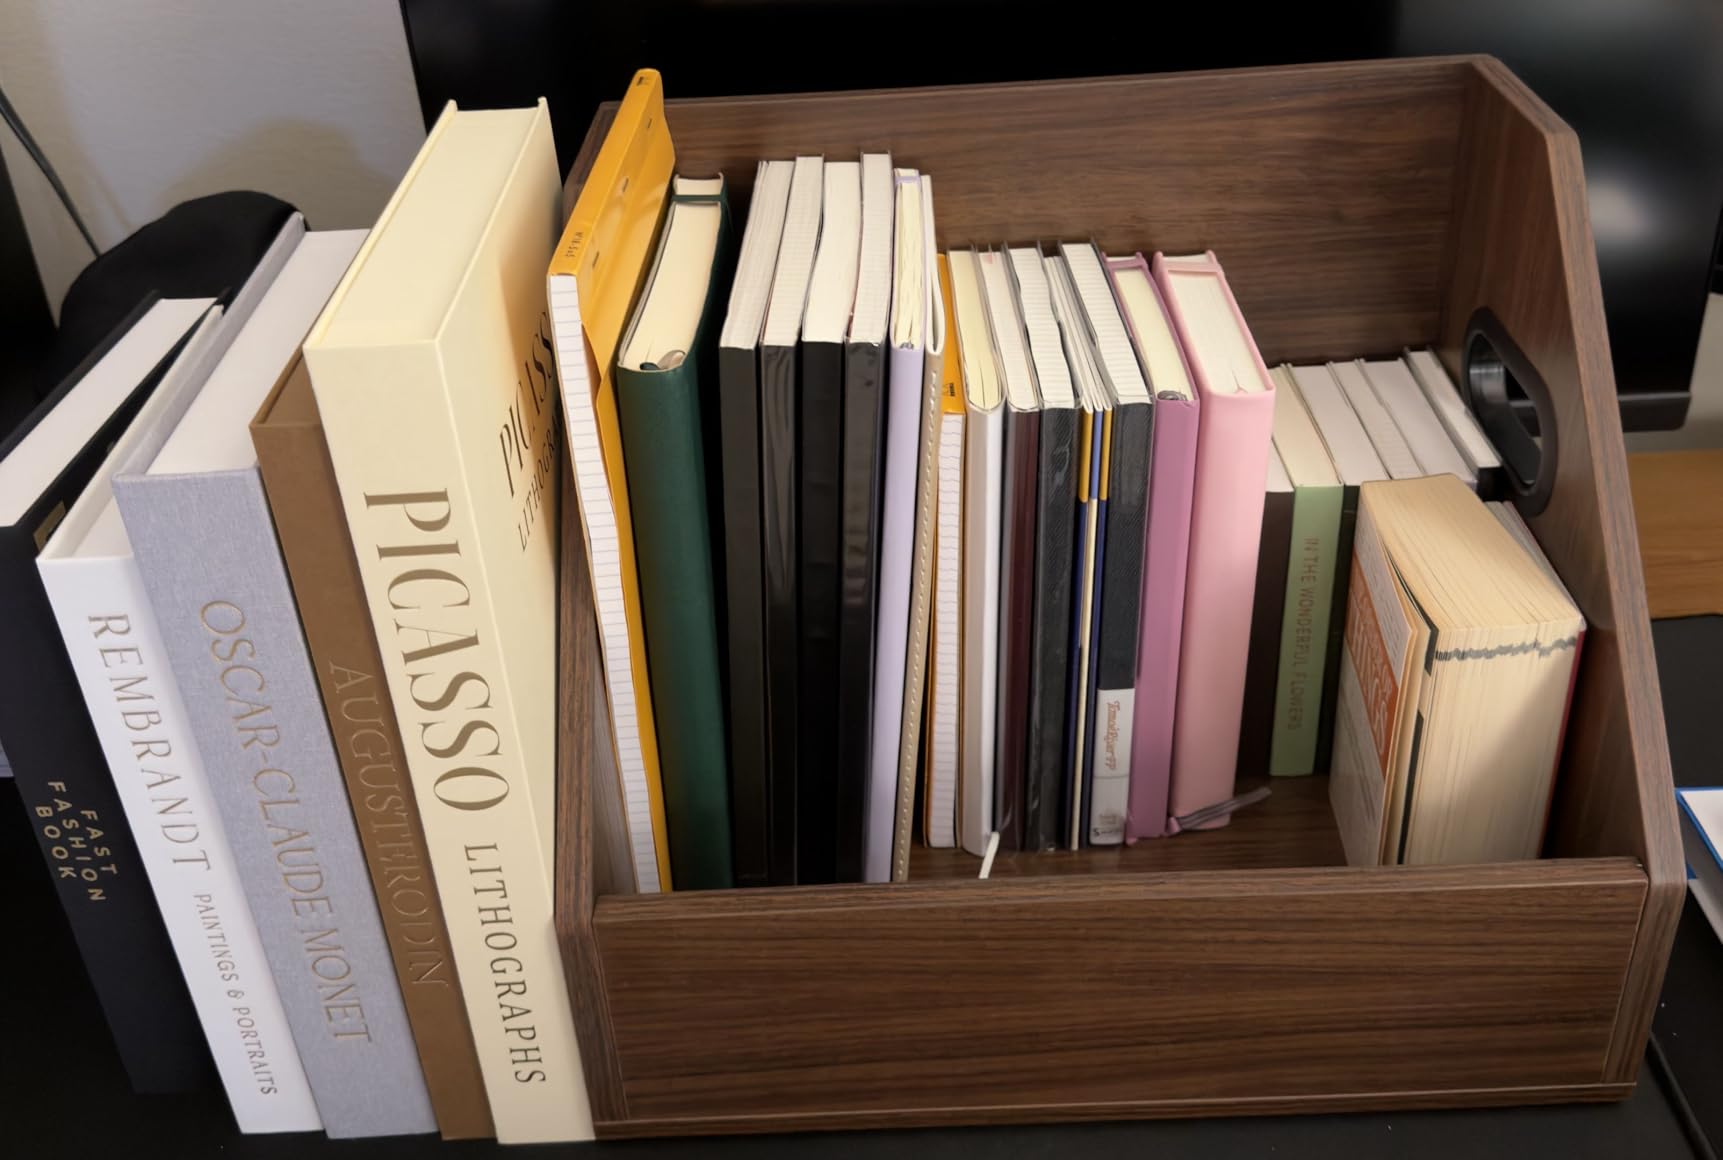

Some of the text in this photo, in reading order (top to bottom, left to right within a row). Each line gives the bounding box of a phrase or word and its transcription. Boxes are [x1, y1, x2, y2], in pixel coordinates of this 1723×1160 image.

[500, 311, 555, 498] PICASS
[1293, 588, 1316, 667] WONDERFUL
[1301, 556, 1320, 583] THE
[363, 488, 510, 811] PICASSO
[35, 806, 77, 878] BOOK
[48, 781, 106, 901] FASHION
[80, 810, 117, 874] FAST
[88, 614, 211, 871] REMBRANDT
[194, 894, 239, 982] PAINTINGS
[232, 1006, 277, 1095] PORTRAITS
[201, 600, 372, 1043] OSCAR-CLAUDE MONET
[464, 842, 546, 1083] LITHOGRAPHS
